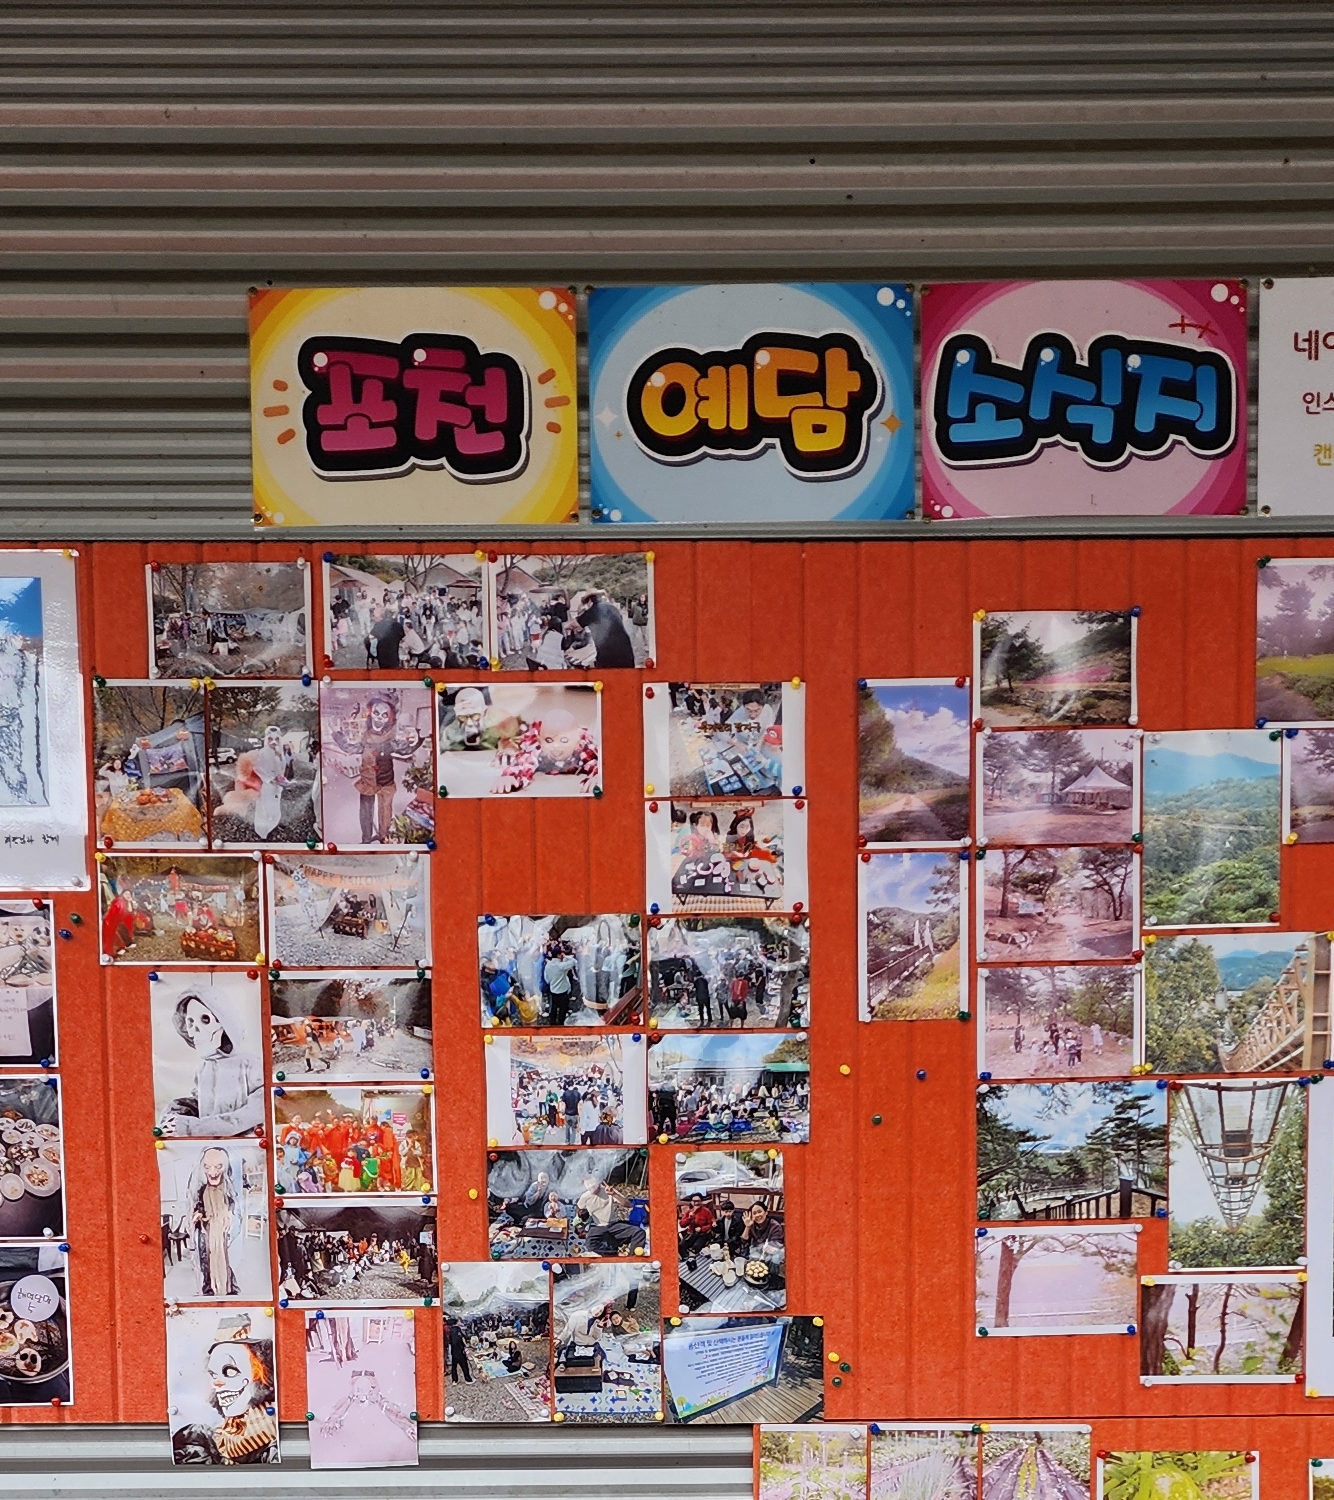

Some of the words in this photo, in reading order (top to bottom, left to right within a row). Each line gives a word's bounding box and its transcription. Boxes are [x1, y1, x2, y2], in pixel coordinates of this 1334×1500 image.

[307, 342, 515, 462] 포천
[635, 342, 865, 463] 예담
[941, 342, 1220, 449] 소식지
